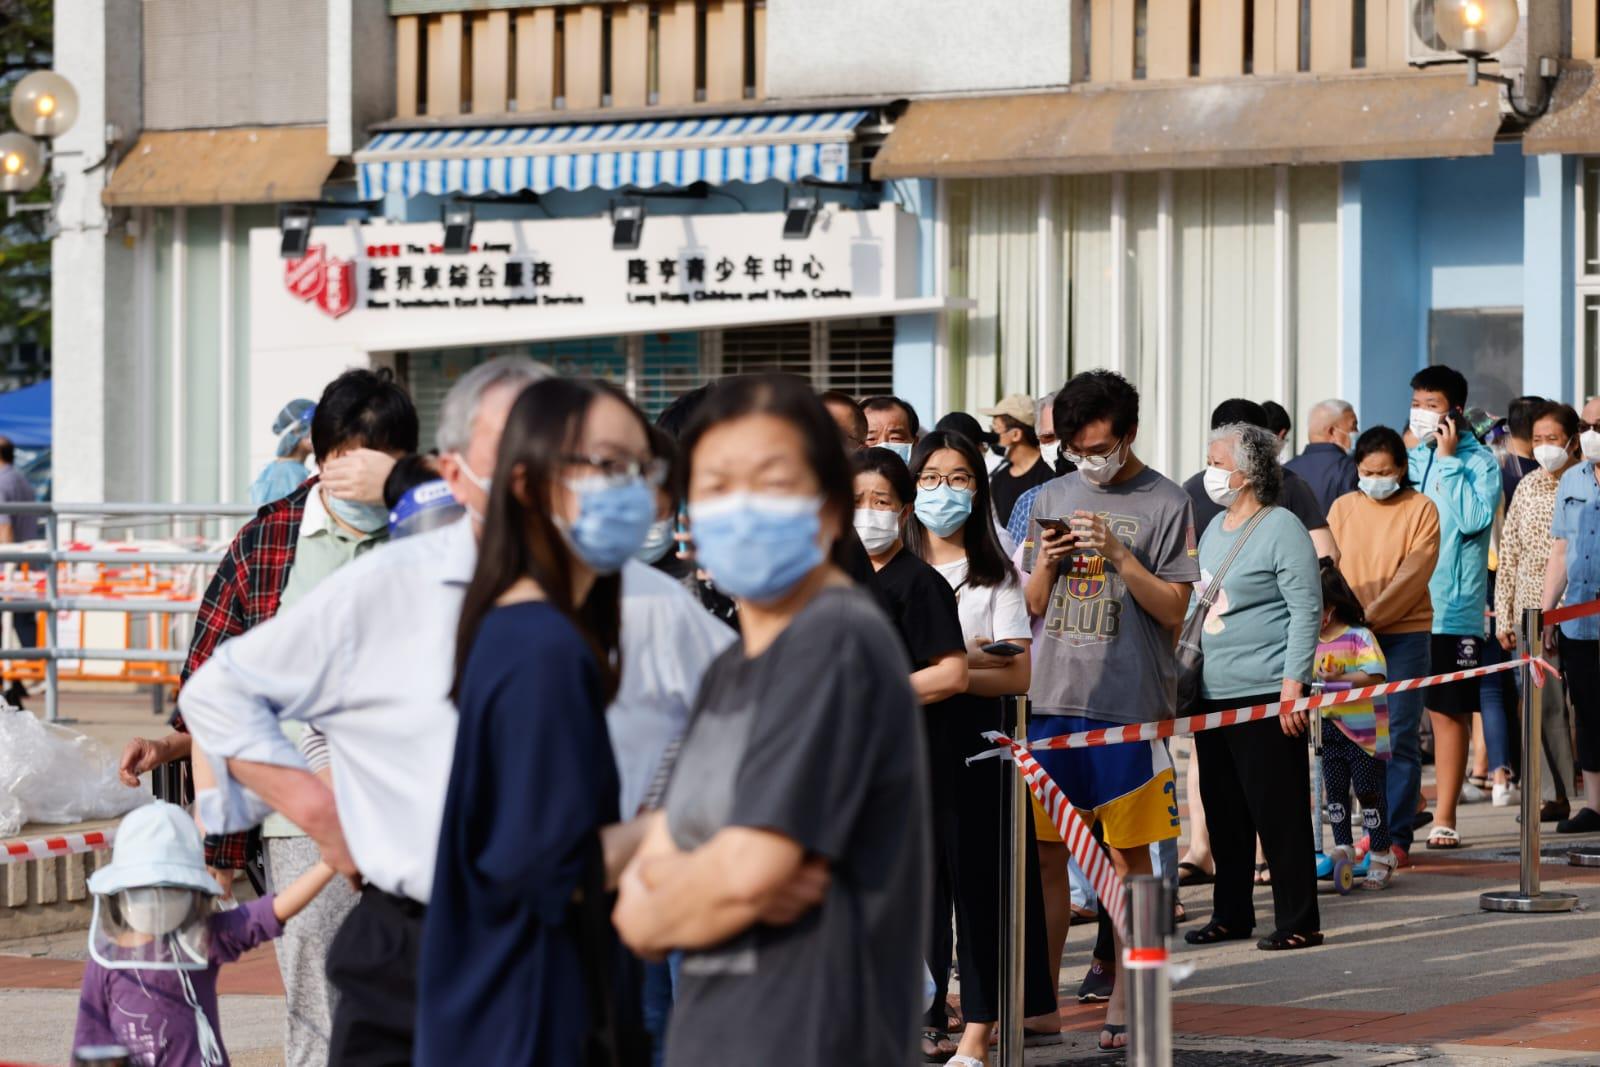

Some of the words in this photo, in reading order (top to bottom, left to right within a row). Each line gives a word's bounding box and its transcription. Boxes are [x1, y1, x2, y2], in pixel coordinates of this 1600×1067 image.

[627, 254, 825, 285] 隆亨青少年中心
[1045, 593, 1123, 637] CLUB
